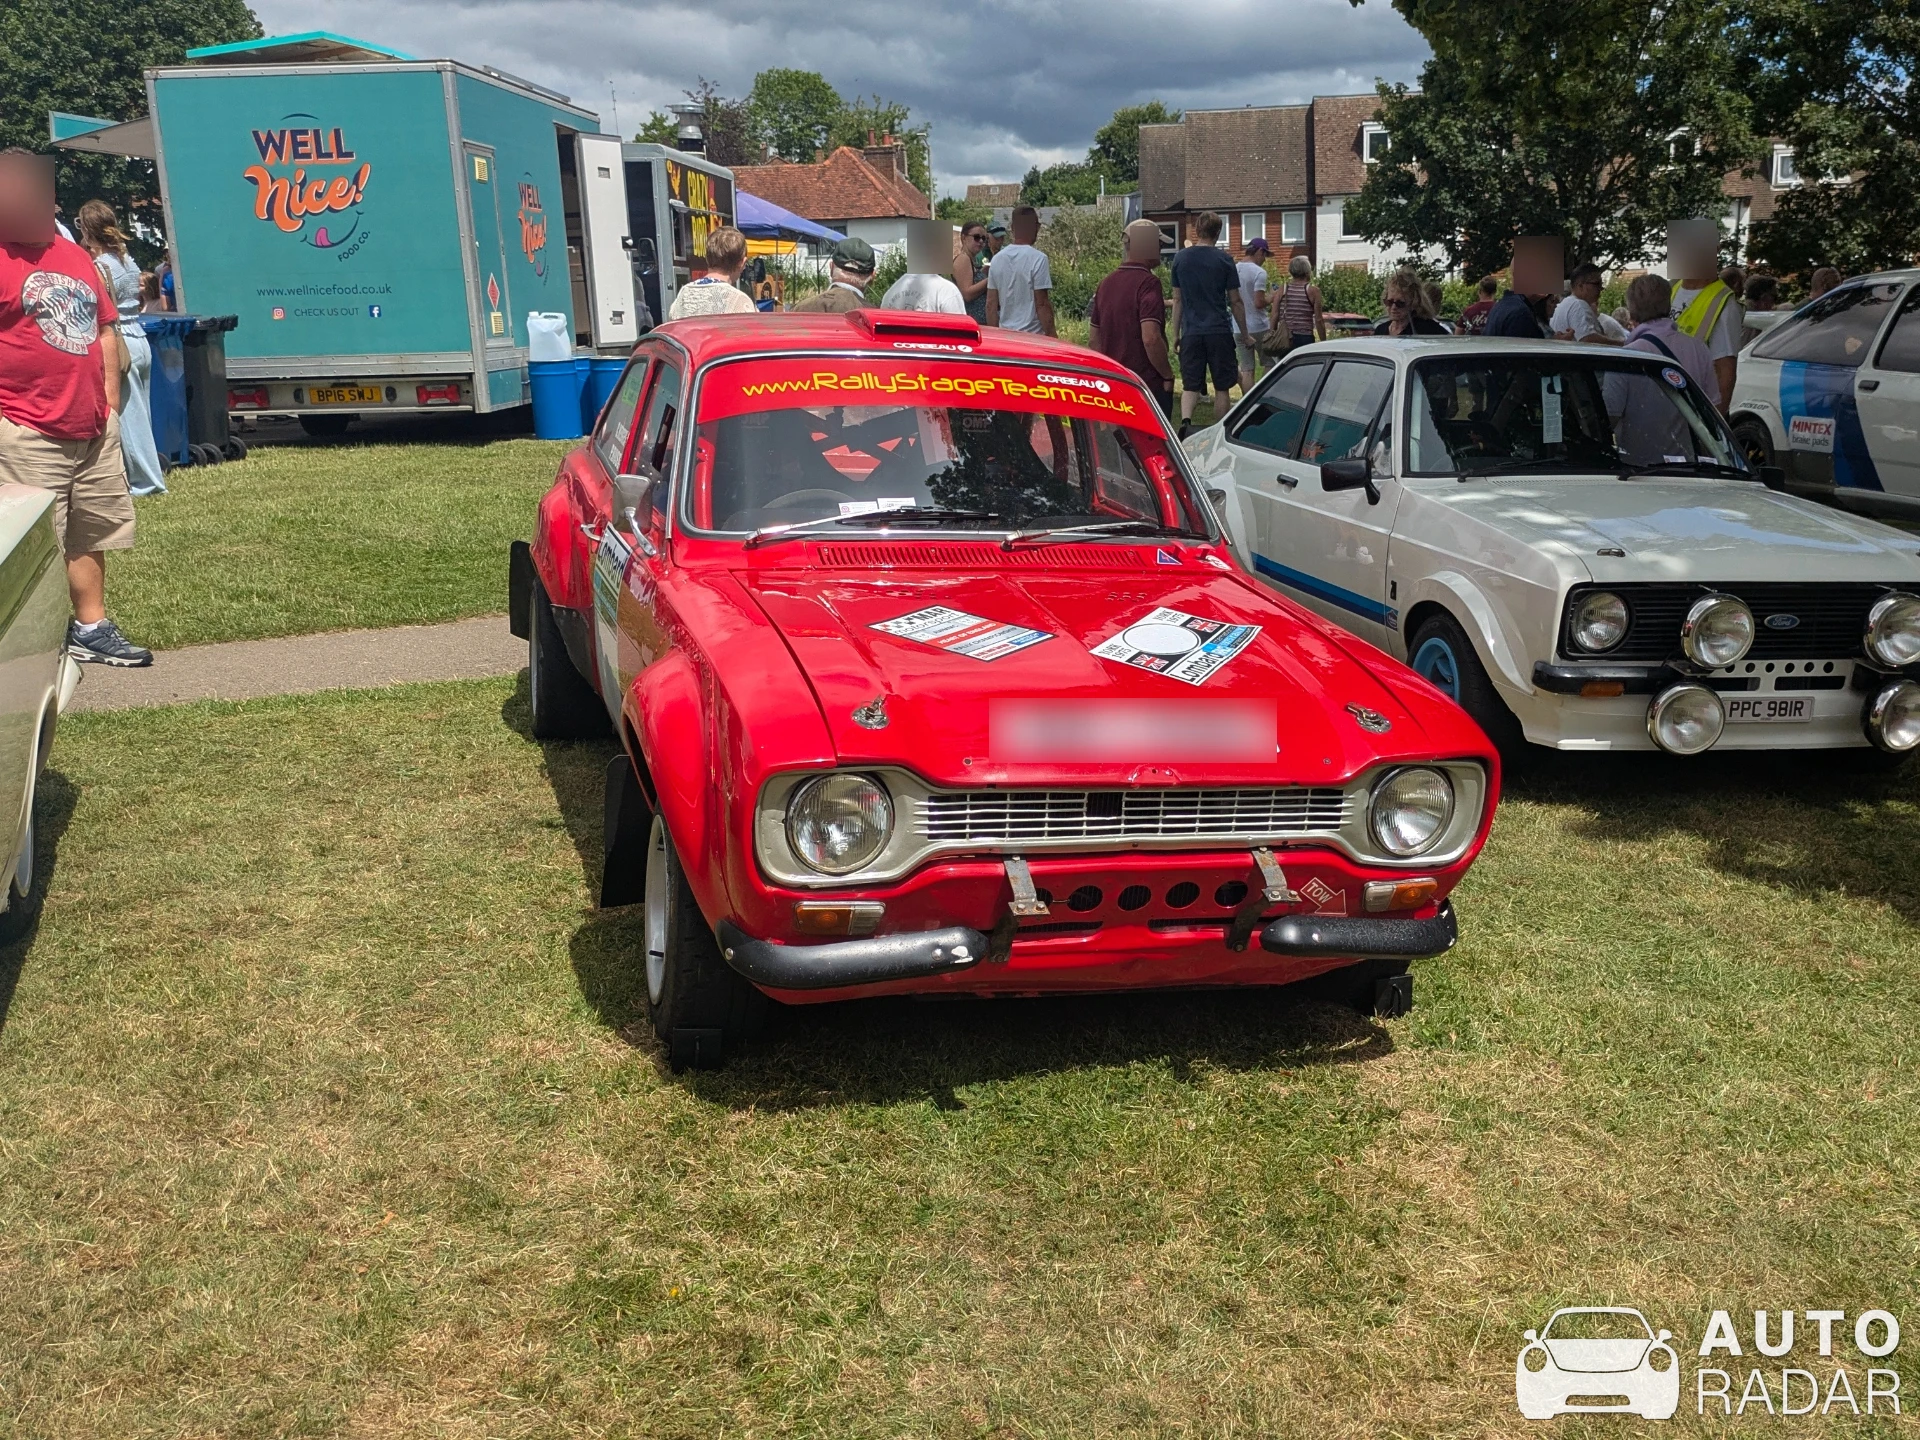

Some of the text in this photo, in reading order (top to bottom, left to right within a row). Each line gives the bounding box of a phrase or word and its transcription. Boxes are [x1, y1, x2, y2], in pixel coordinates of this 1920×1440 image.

[251, 127, 356, 164] WELL
[518, 182, 542, 212] WELL
[337, 230, 371, 263] FOOD CO.
[256, 283, 393, 297] www.wellnicefood.co.uk
[294, 307, 360, 317] CHECK US OUT
[893, 341, 957, 351] CORBEAU
[1037, 373, 1095, 389] CORBEAU
[317, 388, 374, 402] BP16 SWJ
[741, 371, 1137, 416] www.RallyStageTeam.co.uk
[1740, 402, 1769, 410] DUNLOP
[962, 415, 991, 429] OMP
[1792, 420, 1832, 435] MINTEX
[1791, 435, 1829, 448] brake pads
[1772, 616, 1792, 626] Ford
[1729, 700, 1804, 718] PPC 981R
[1306, 881, 1334, 904] TOW
